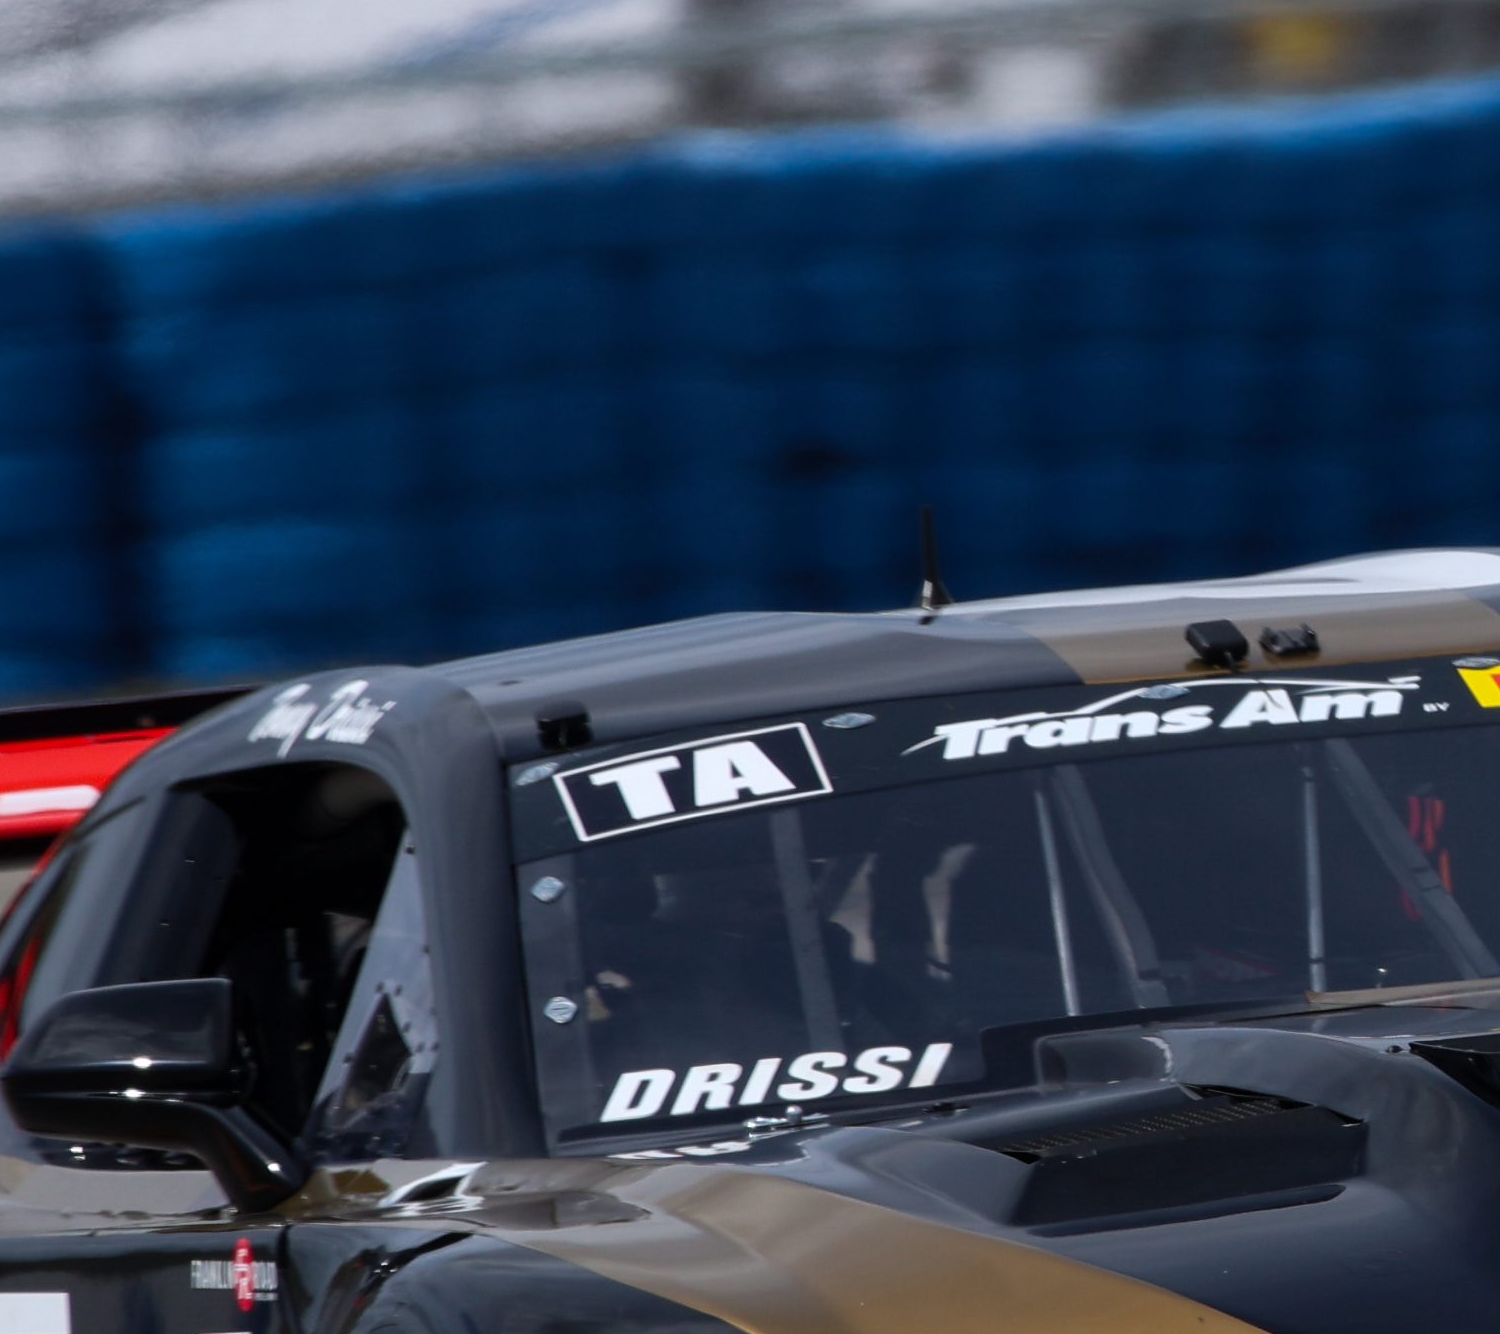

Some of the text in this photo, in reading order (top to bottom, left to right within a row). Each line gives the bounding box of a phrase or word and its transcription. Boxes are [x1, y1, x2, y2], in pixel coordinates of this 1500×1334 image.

[935, 705, 1214, 760] Trans
[1220, 688, 1402, 729] Am
[589, 741, 797, 821] TA
[600, 1043, 953, 1123] DRISSI
